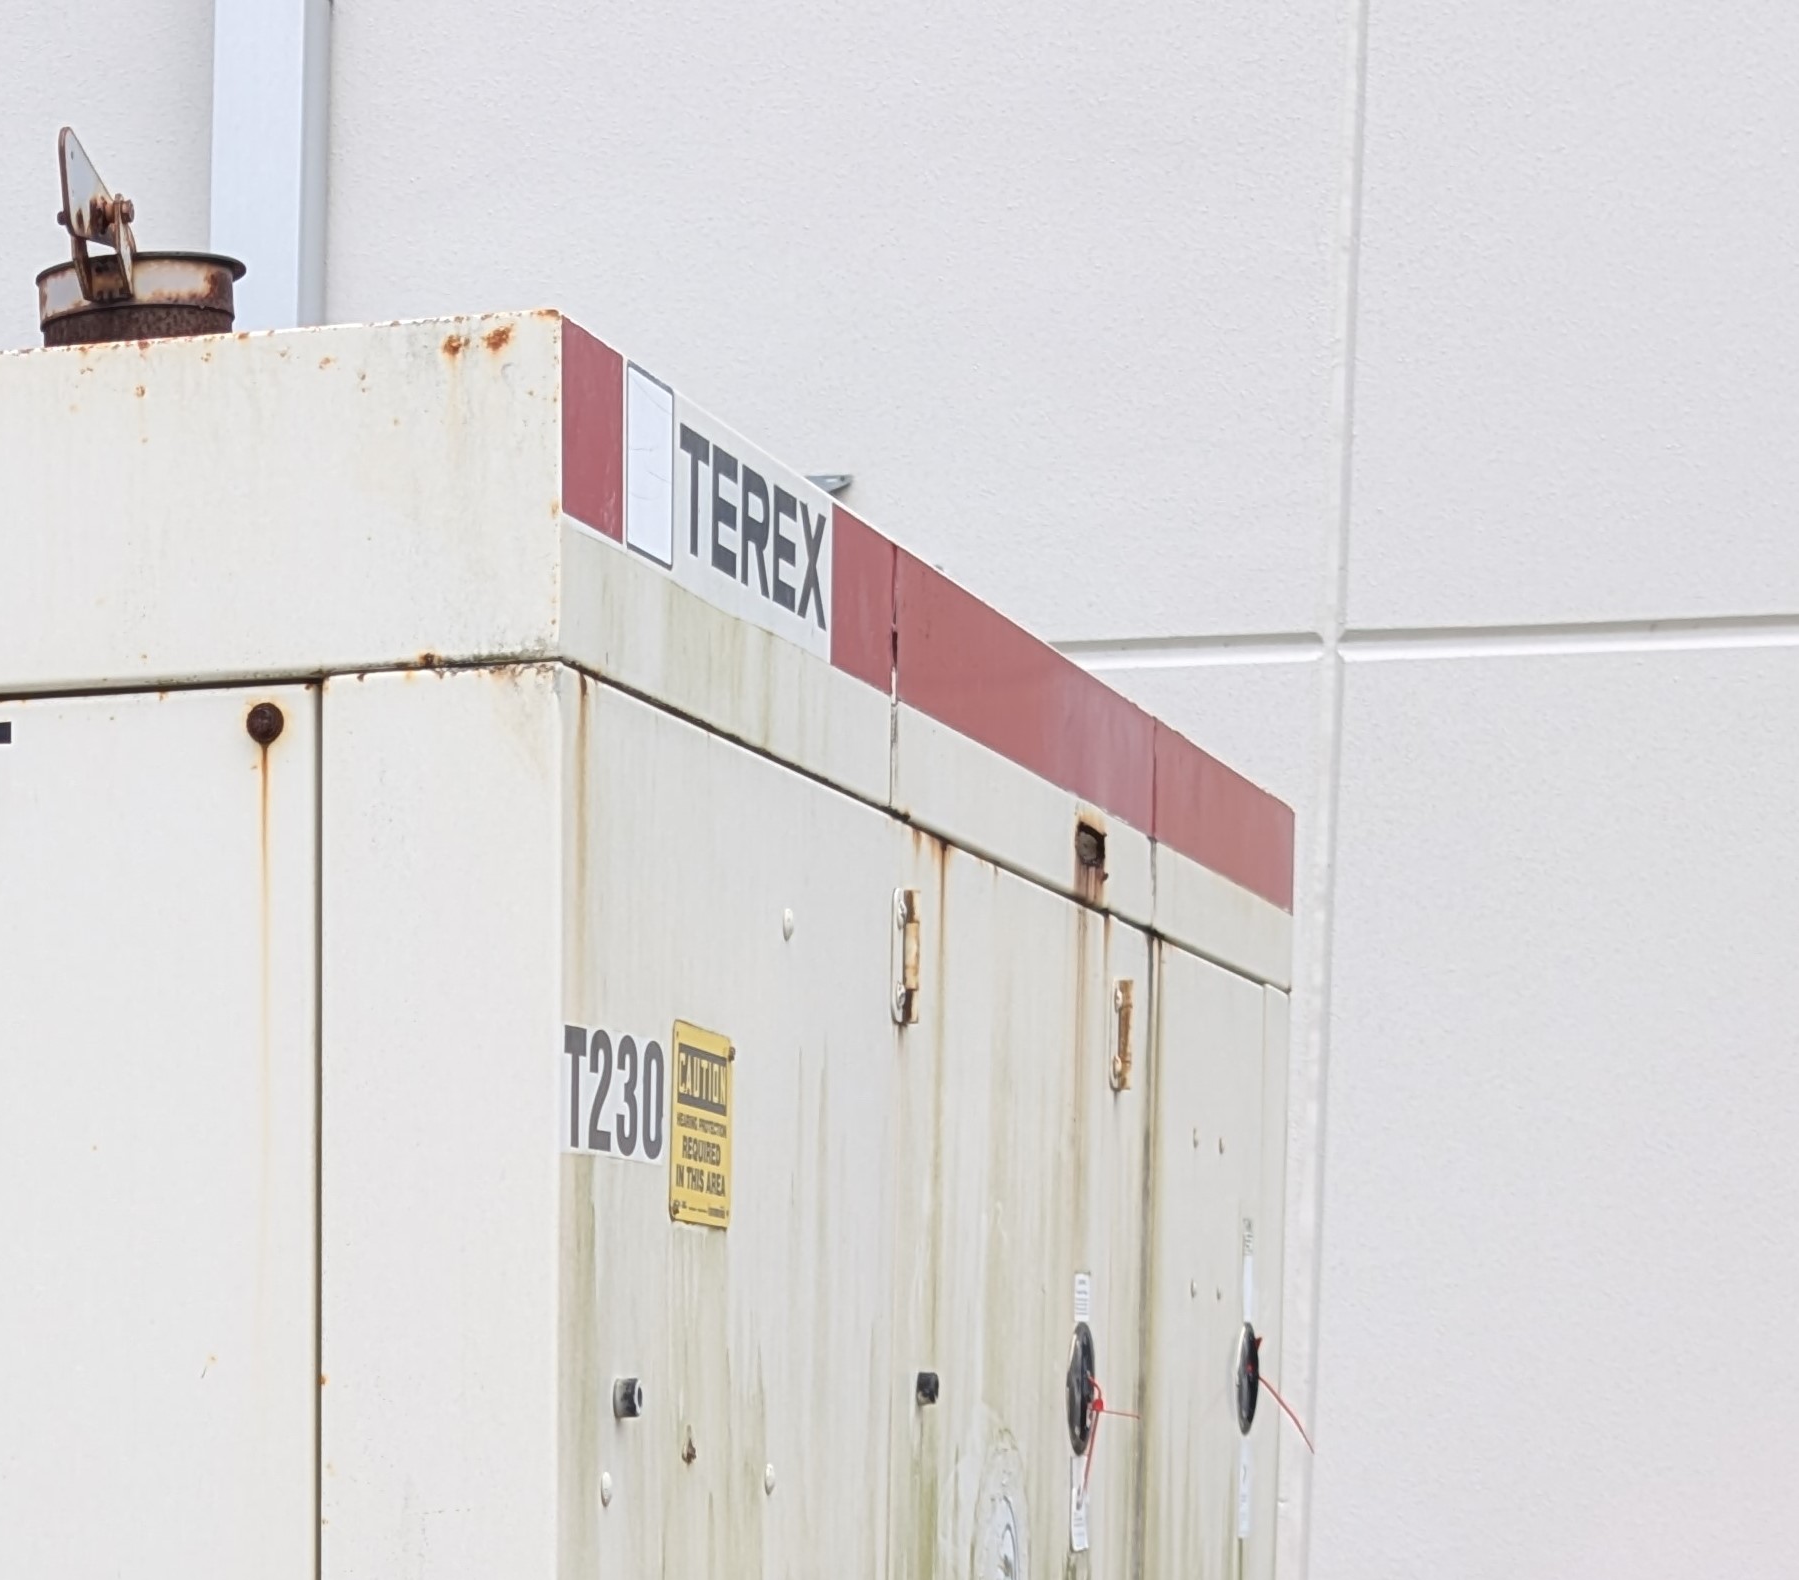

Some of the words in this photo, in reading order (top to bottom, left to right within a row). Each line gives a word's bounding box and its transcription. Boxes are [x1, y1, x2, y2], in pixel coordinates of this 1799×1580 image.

[679, 422, 827, 632] TEREX
[564, 1024, 664, 1160] T230
[677, 1051, 727, 1106] CAUTION
[677, 1110, 698, 1131] HEARING
[698, 1116, 727, 1139] PROTECTION
[682, 1135, 721, 1167] REQUIRED
[676, 1164, 685, 1188] IN
[686, 1166, 704, 1192] THIS
[705, 1170, 726, 1197] AREA
